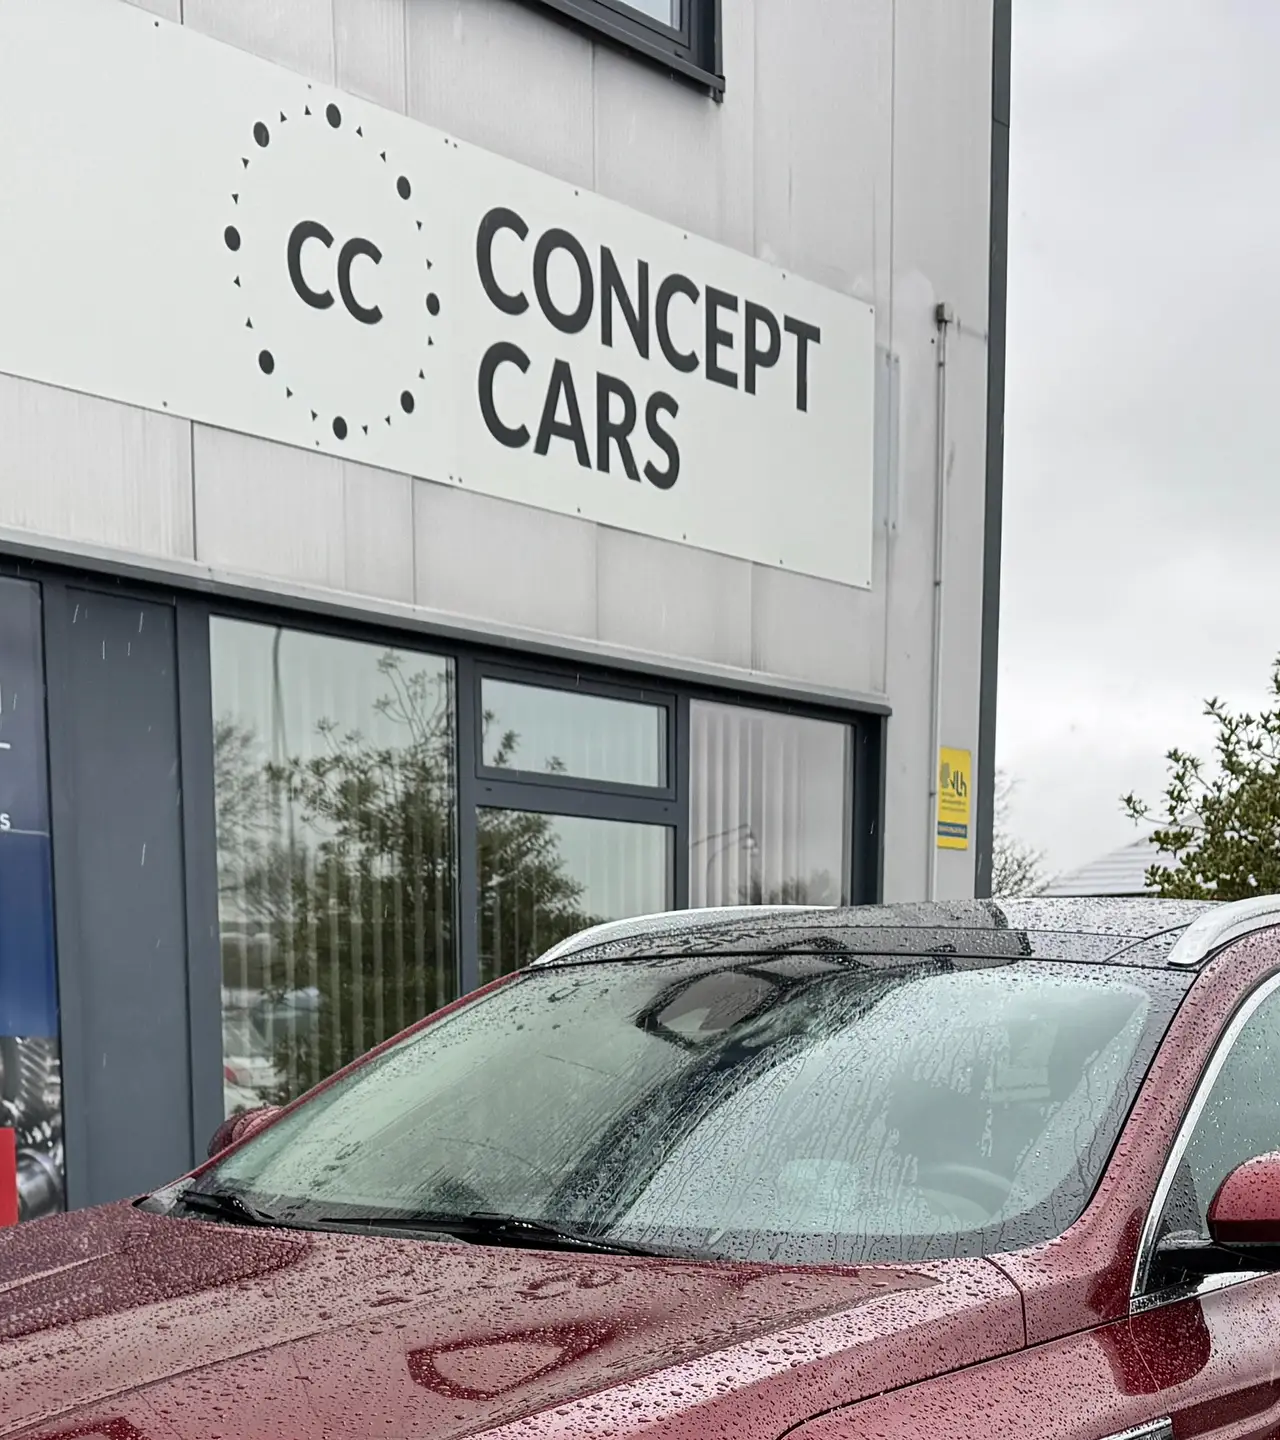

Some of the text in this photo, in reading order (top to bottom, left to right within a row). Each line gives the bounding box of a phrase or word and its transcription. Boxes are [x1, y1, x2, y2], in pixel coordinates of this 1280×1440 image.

[286, 220, 383, 325] CC
[476, 207, 821, 413] CONCEPT
[478, 341, 680, 490] CARS
